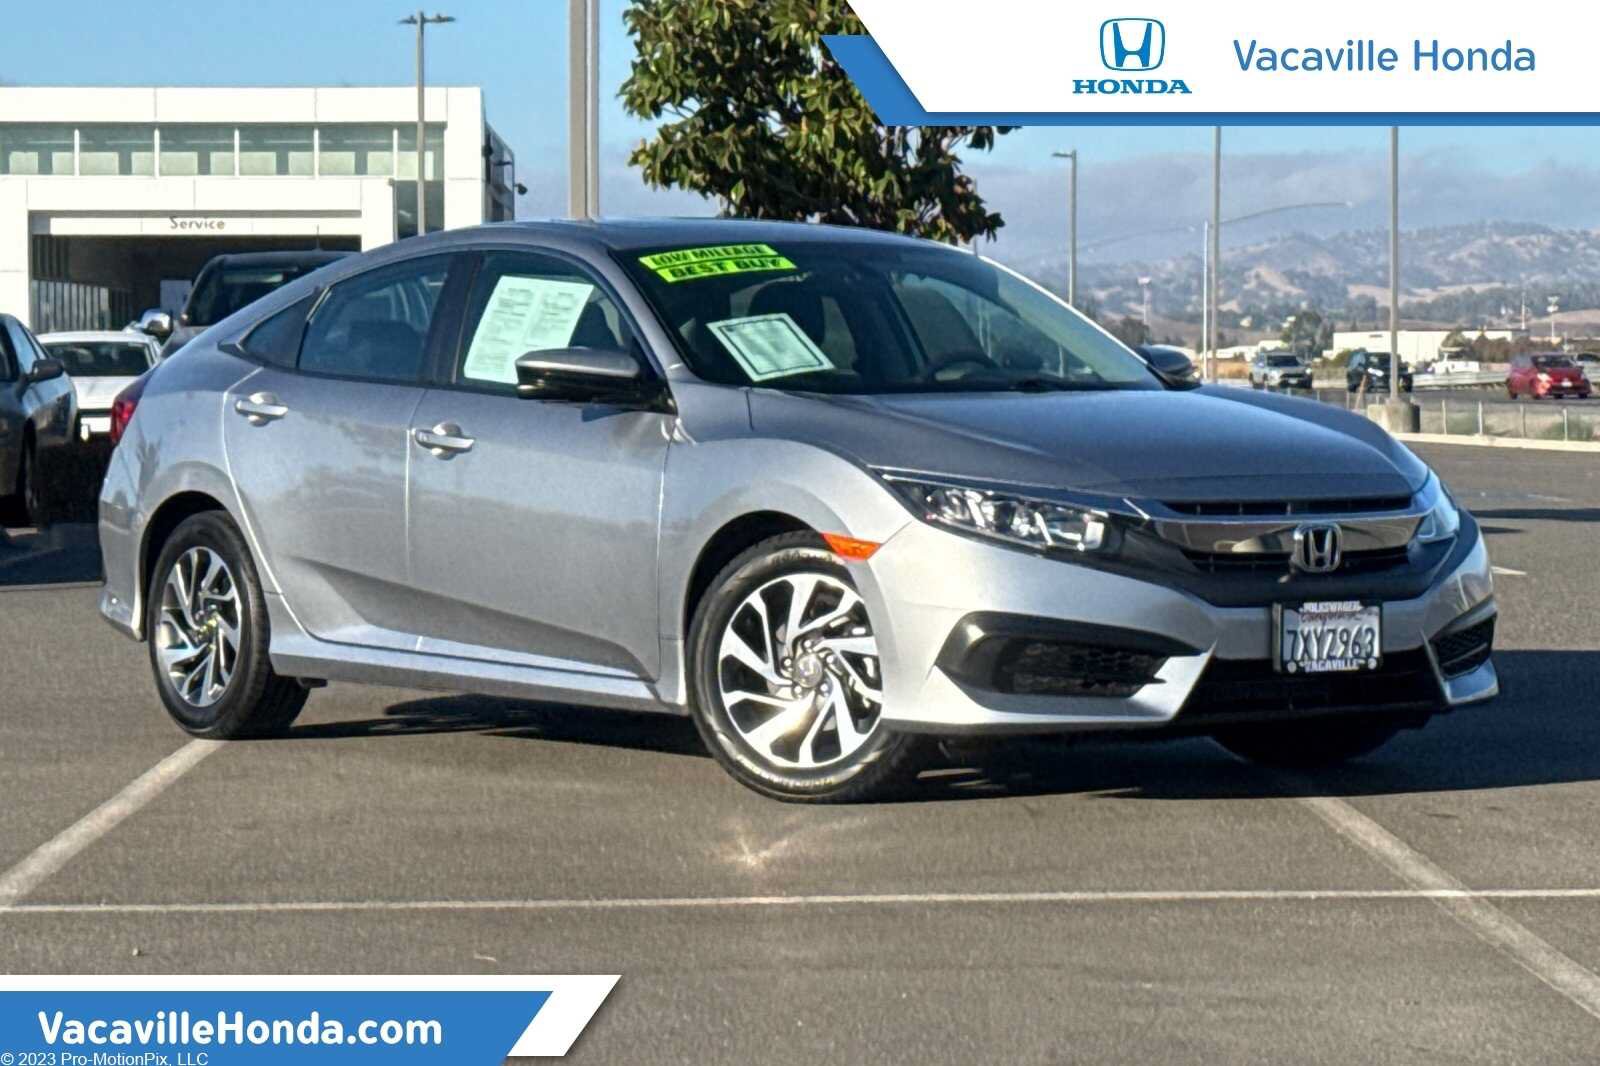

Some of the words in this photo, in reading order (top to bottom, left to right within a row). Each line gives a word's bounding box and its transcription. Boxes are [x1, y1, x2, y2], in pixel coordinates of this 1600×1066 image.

[169, 216, 225, 230] Service
[651, 252, 689, 266] LOW
[692, 244, 764, 258] MILEAGE
[669, 262, 728, 279] BEST
[738, 258, 781, 269] BUY
[1287, 628, 1375, 660] 7XYZ963
[1304, 659, 1360, 673] VACAVILLE
